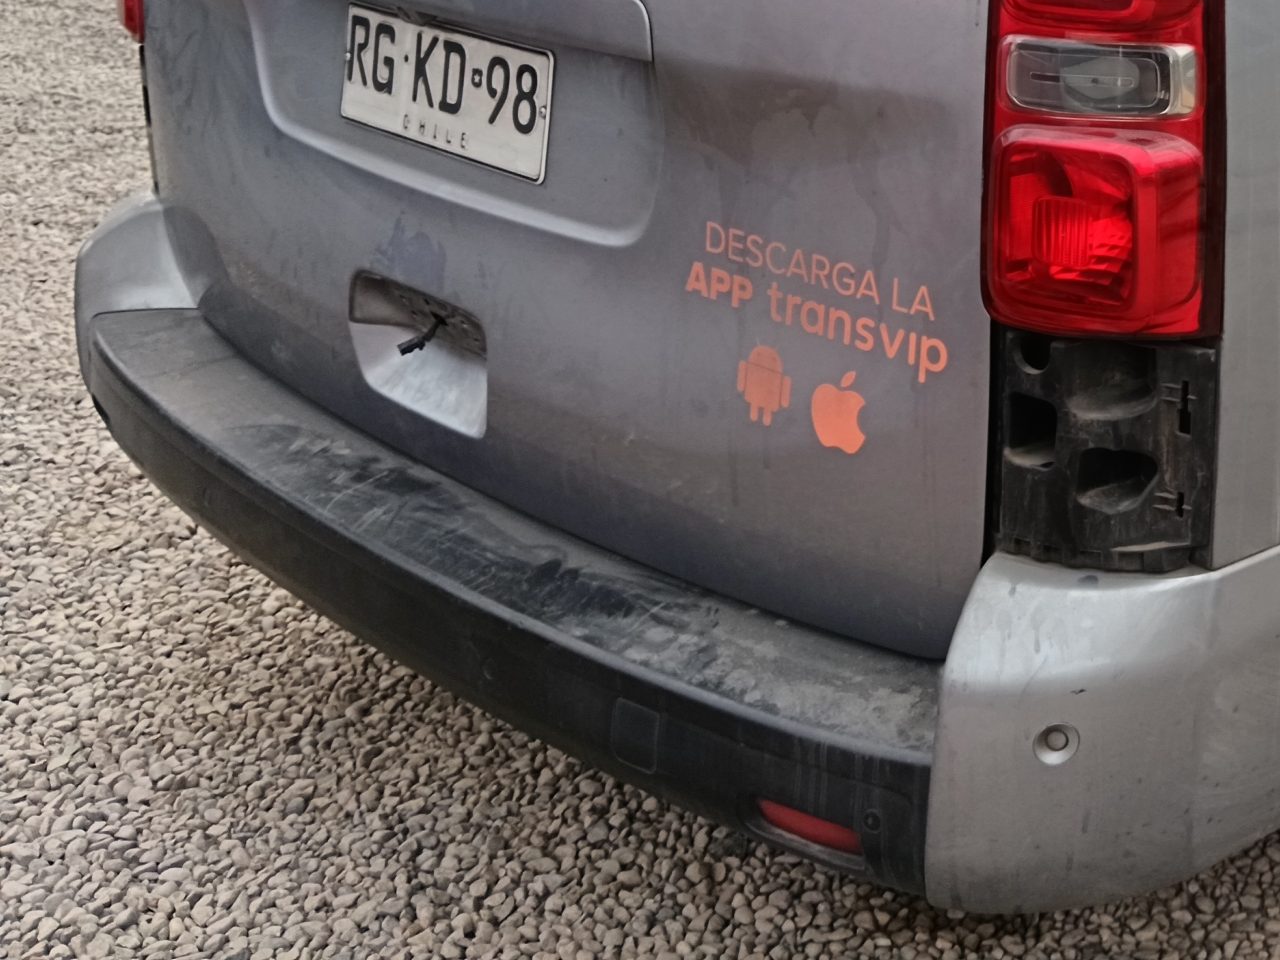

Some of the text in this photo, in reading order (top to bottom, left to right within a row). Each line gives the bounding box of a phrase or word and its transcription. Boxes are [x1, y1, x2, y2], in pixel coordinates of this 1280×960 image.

[402, 113, 468, 150] CHILE
[684, 260, 949, 384] APP transvip
[705, 220, 936, 322] DESCARGA LA
